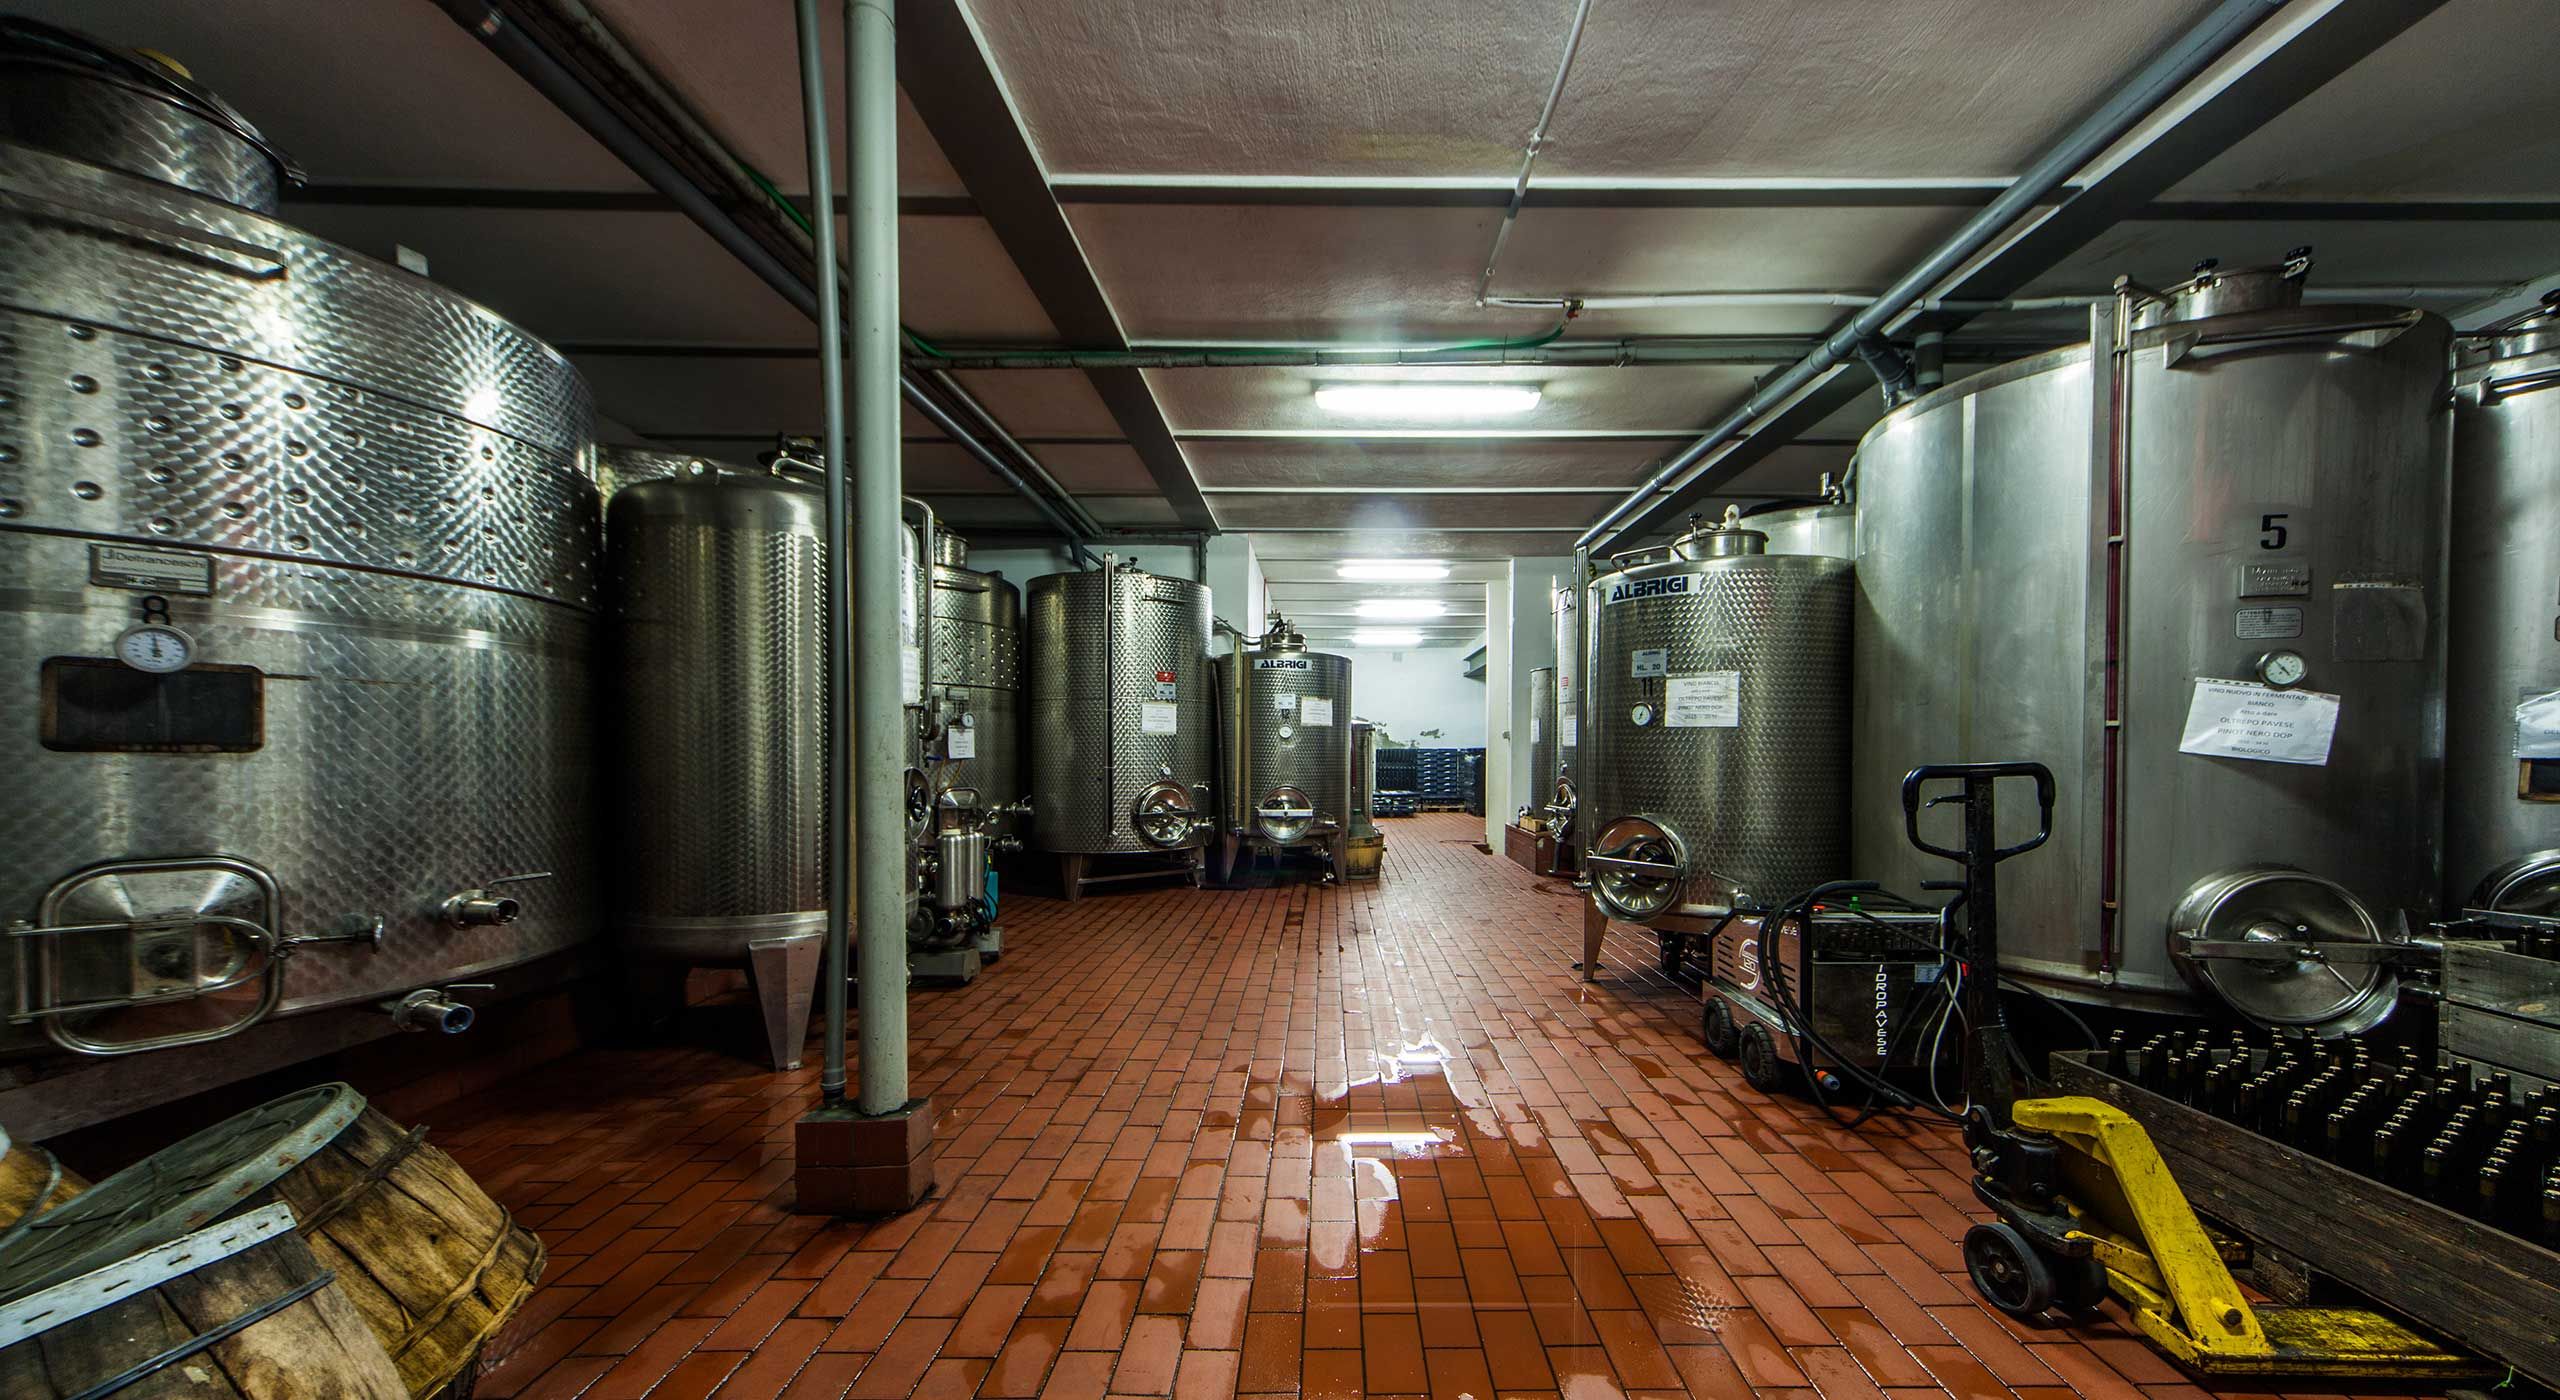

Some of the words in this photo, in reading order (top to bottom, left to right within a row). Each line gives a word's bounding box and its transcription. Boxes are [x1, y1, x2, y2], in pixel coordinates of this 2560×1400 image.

[2260, 513, 2289, 550] 5
[1611, 576, 1689, 602] ALBRIGI
[143, 595, 173, 625] 8
[1260, 659, 1307, 669] ALBRIGI
[2246, 730, 2271, 738] NERO
[2272, 731, 2293, 739] DOP
[2261, 719, 2295, 729] PAVESE
[1875, 964, 1888, 1056] IDROPAVESE
